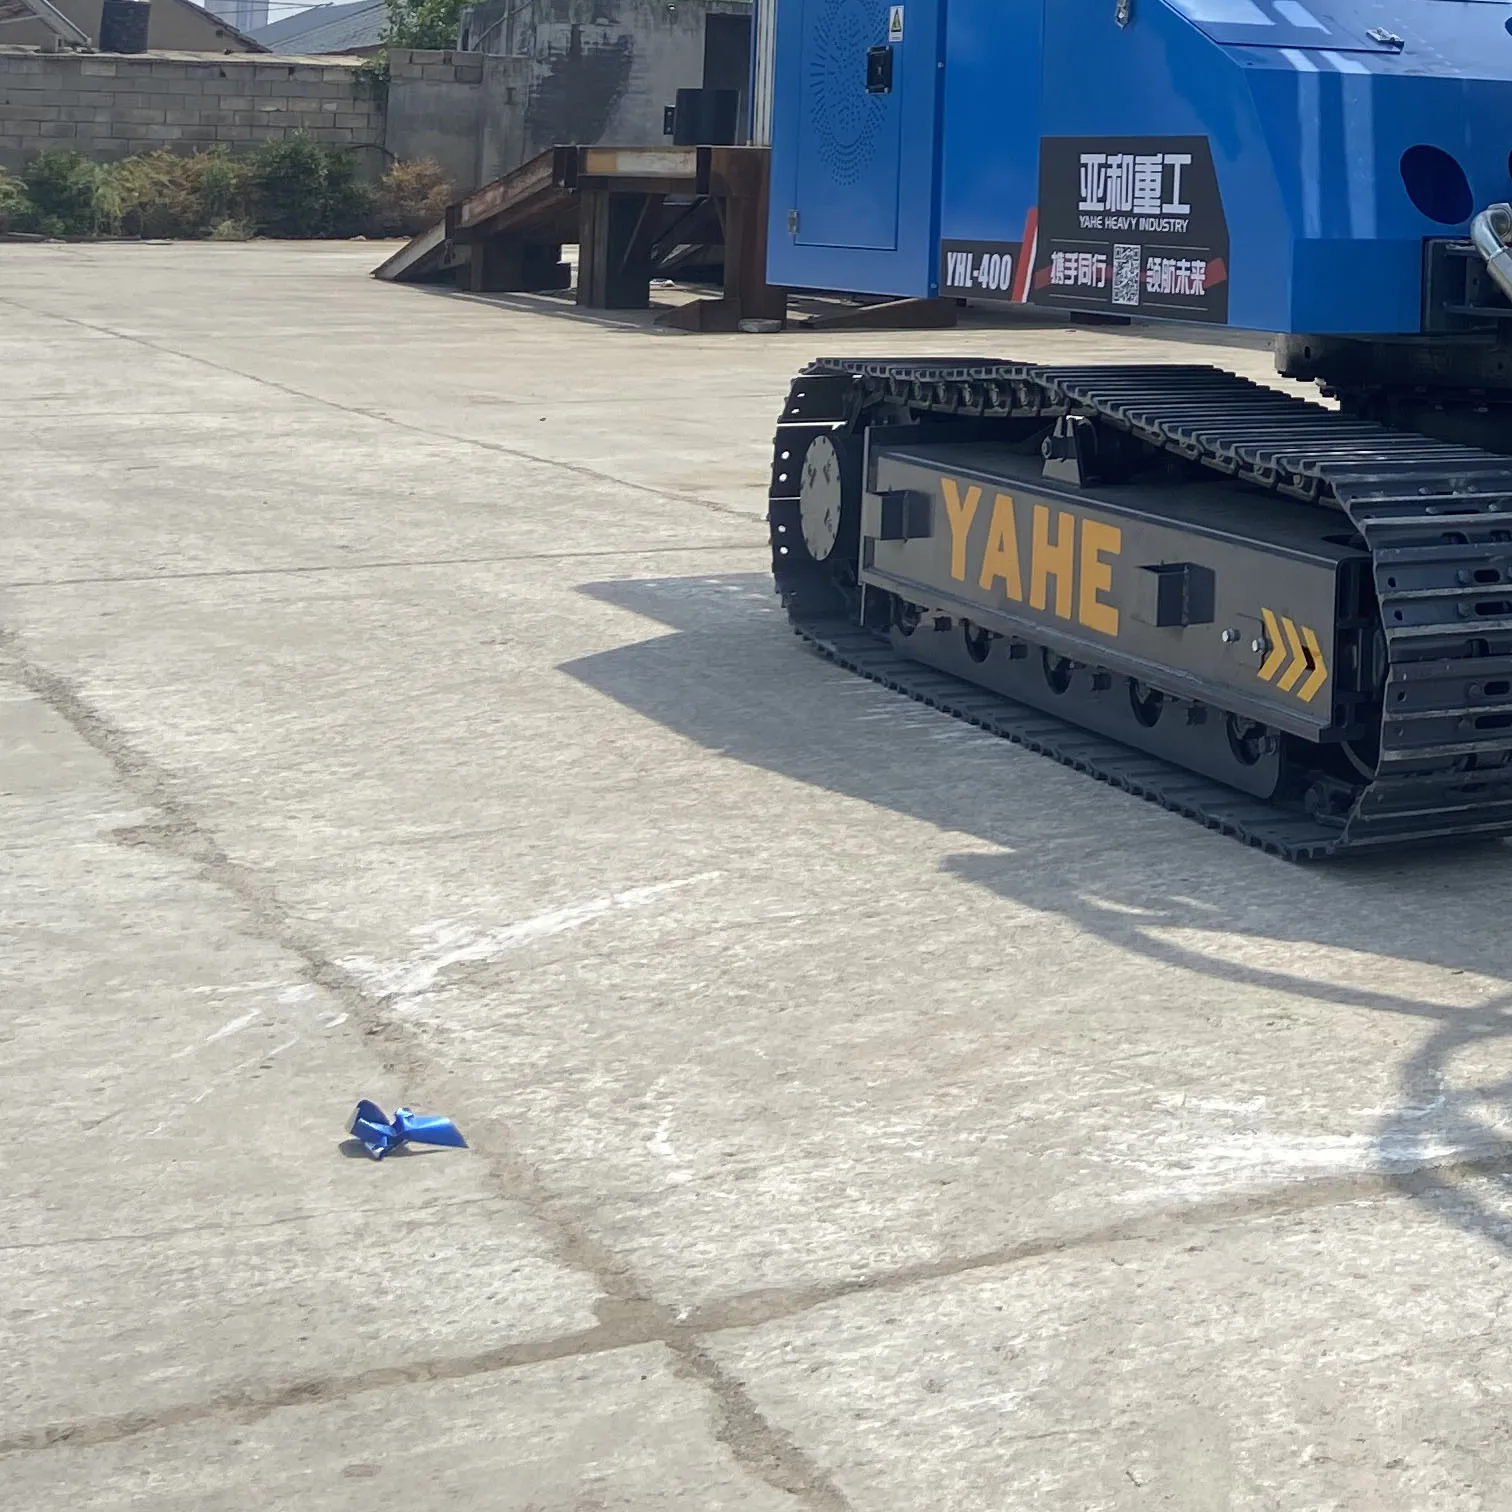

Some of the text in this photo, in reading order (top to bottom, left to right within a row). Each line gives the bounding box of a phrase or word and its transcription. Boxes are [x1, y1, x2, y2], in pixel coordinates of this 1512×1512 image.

[1078, 153, 1192, 214] 亚和重工
[1079, 215, 1189, 233] YAHE HEAVY INDUSTRY
[946, 251, 1013, 291] YHL-400
[1050, 250, 1207, 296] 携手同行 领航未来
[941, 477, 1122, 637] YAHE
